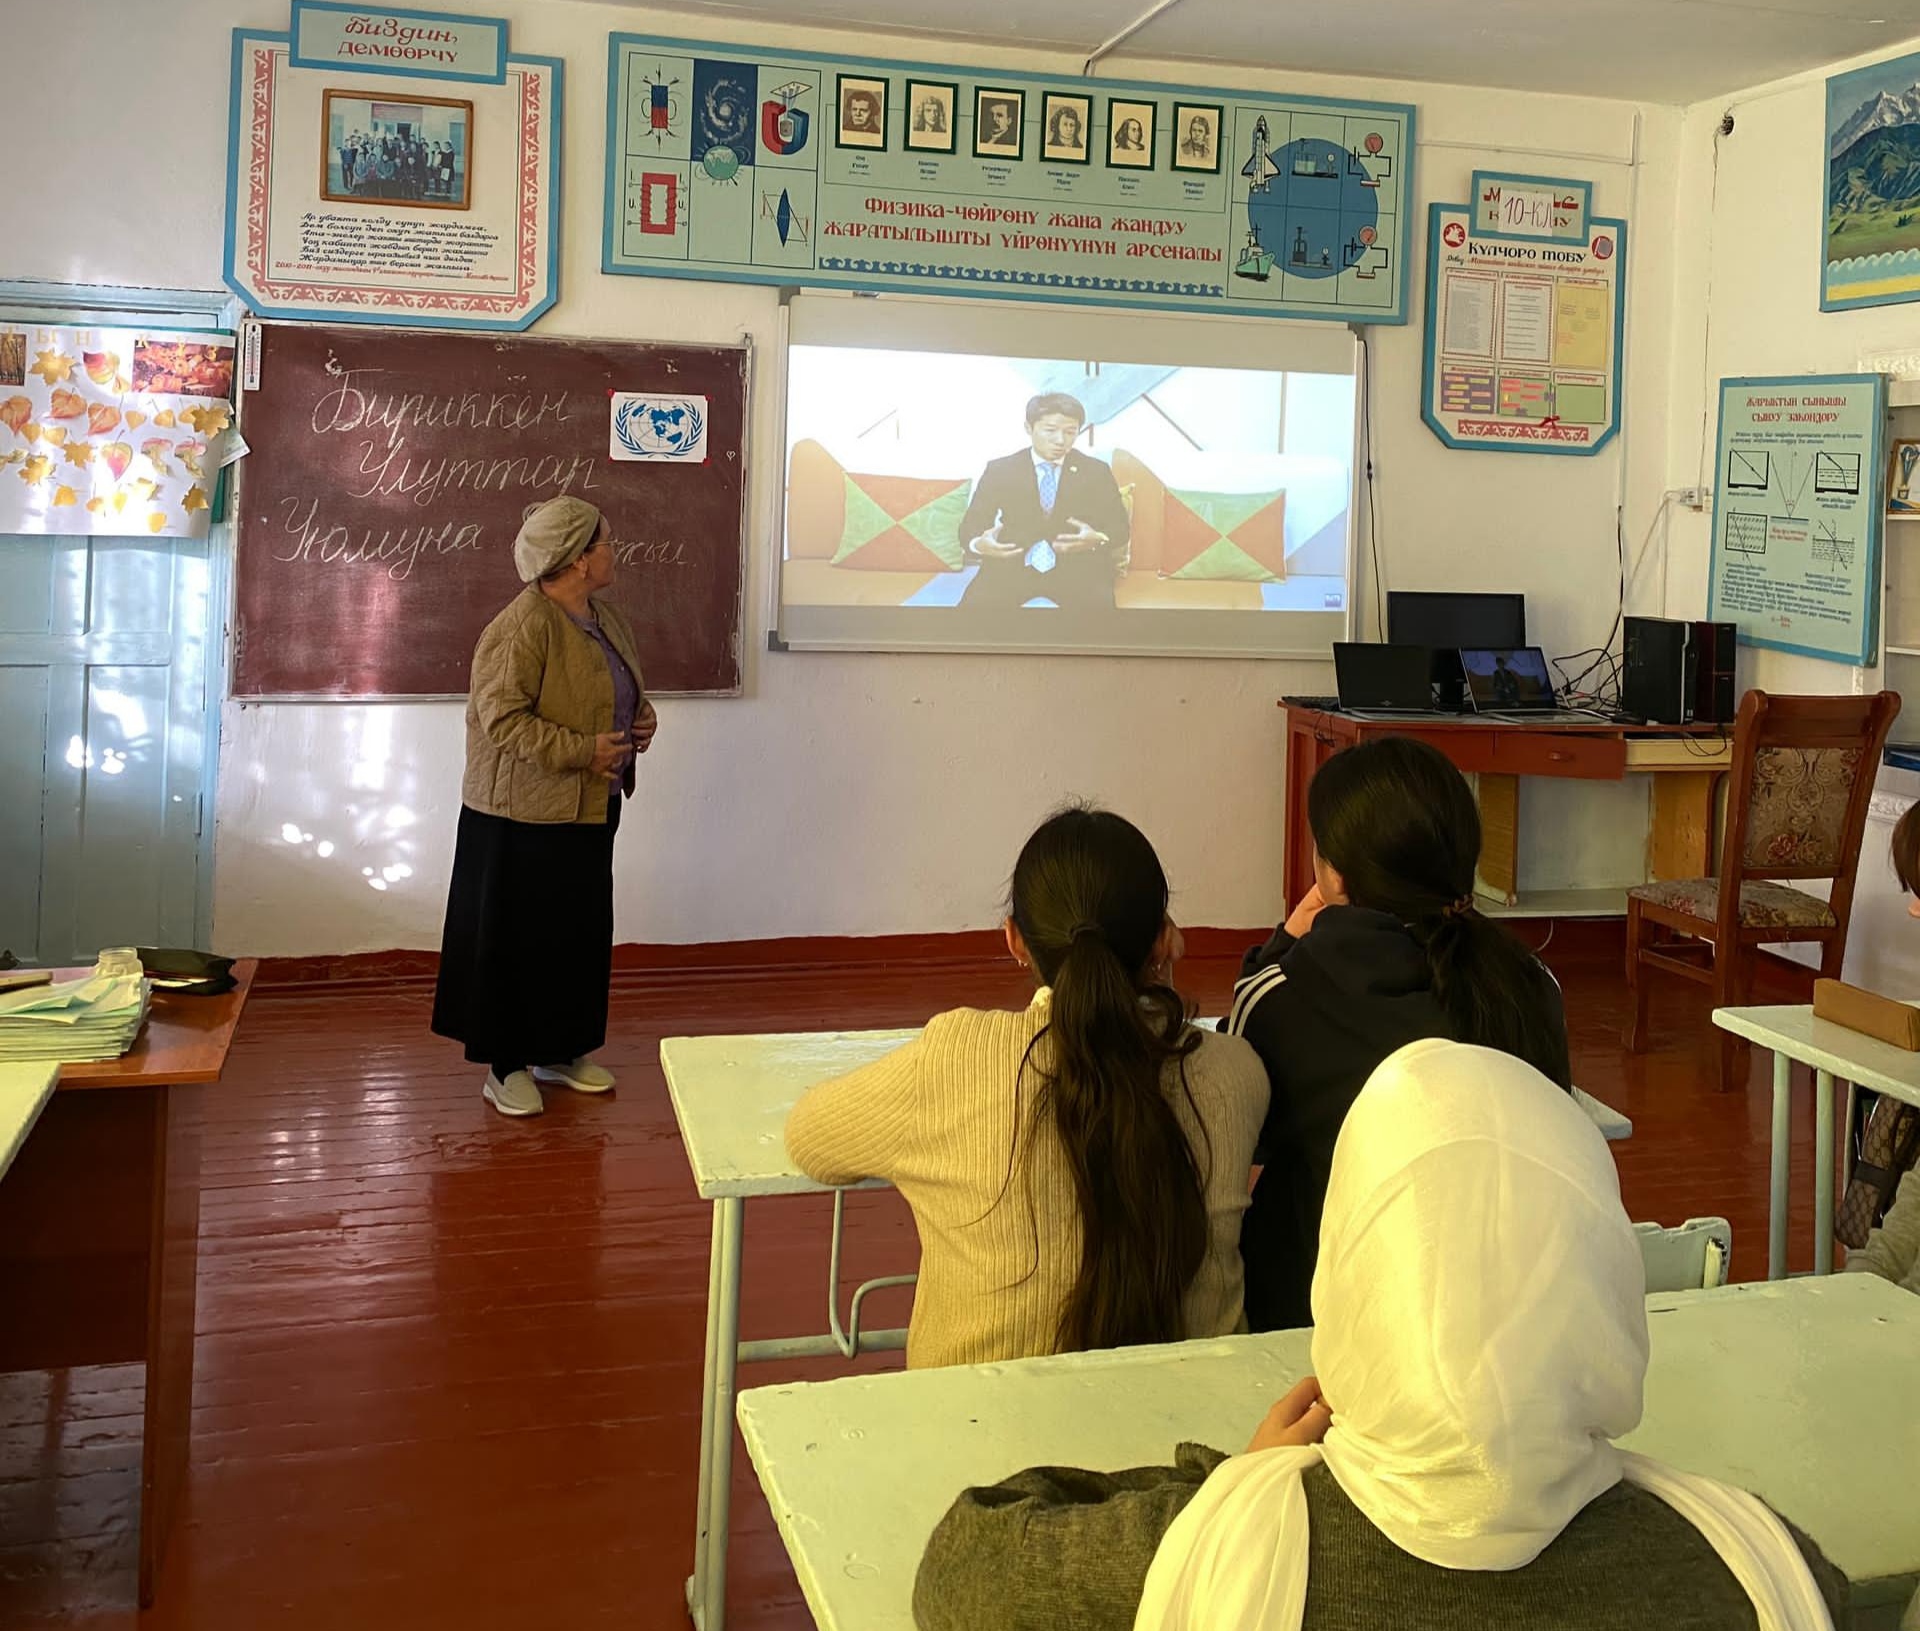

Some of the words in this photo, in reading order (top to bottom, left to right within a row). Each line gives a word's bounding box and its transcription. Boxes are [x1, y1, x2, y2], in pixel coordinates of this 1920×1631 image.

[312, 368, 576, 448] Бириккен
[348, 437, 601, 507] Улуттар
[273, 496, 487, 581] Уюмуна
